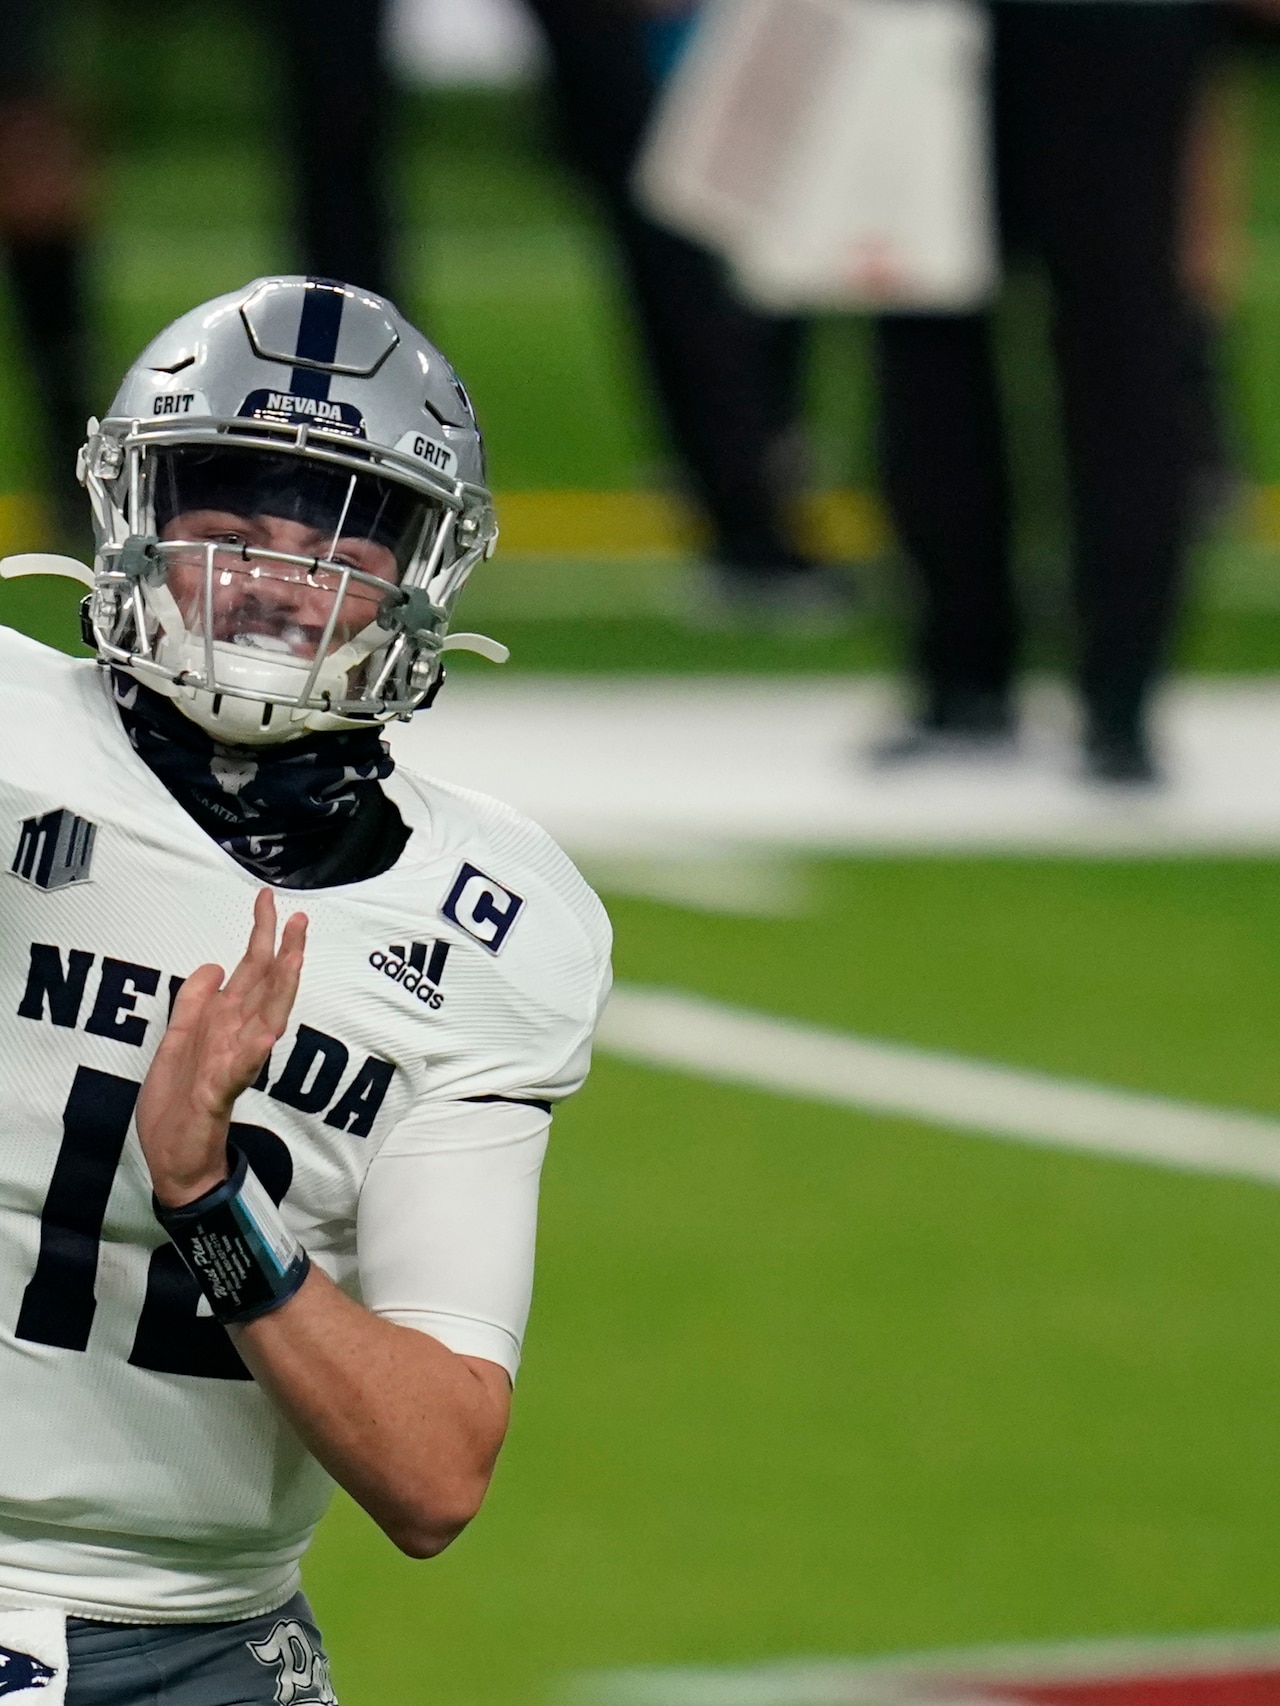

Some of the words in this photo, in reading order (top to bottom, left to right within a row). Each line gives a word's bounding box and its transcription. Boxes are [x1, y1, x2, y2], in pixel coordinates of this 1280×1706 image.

[153, 394, 195, 415] GRIT
[267, 393, 343, 422] NEVADA
[413, 436, 452, 471] GRIT
[368, 950, 445, 1010] adidas
[16, 942, 397, 1138] NEDA
